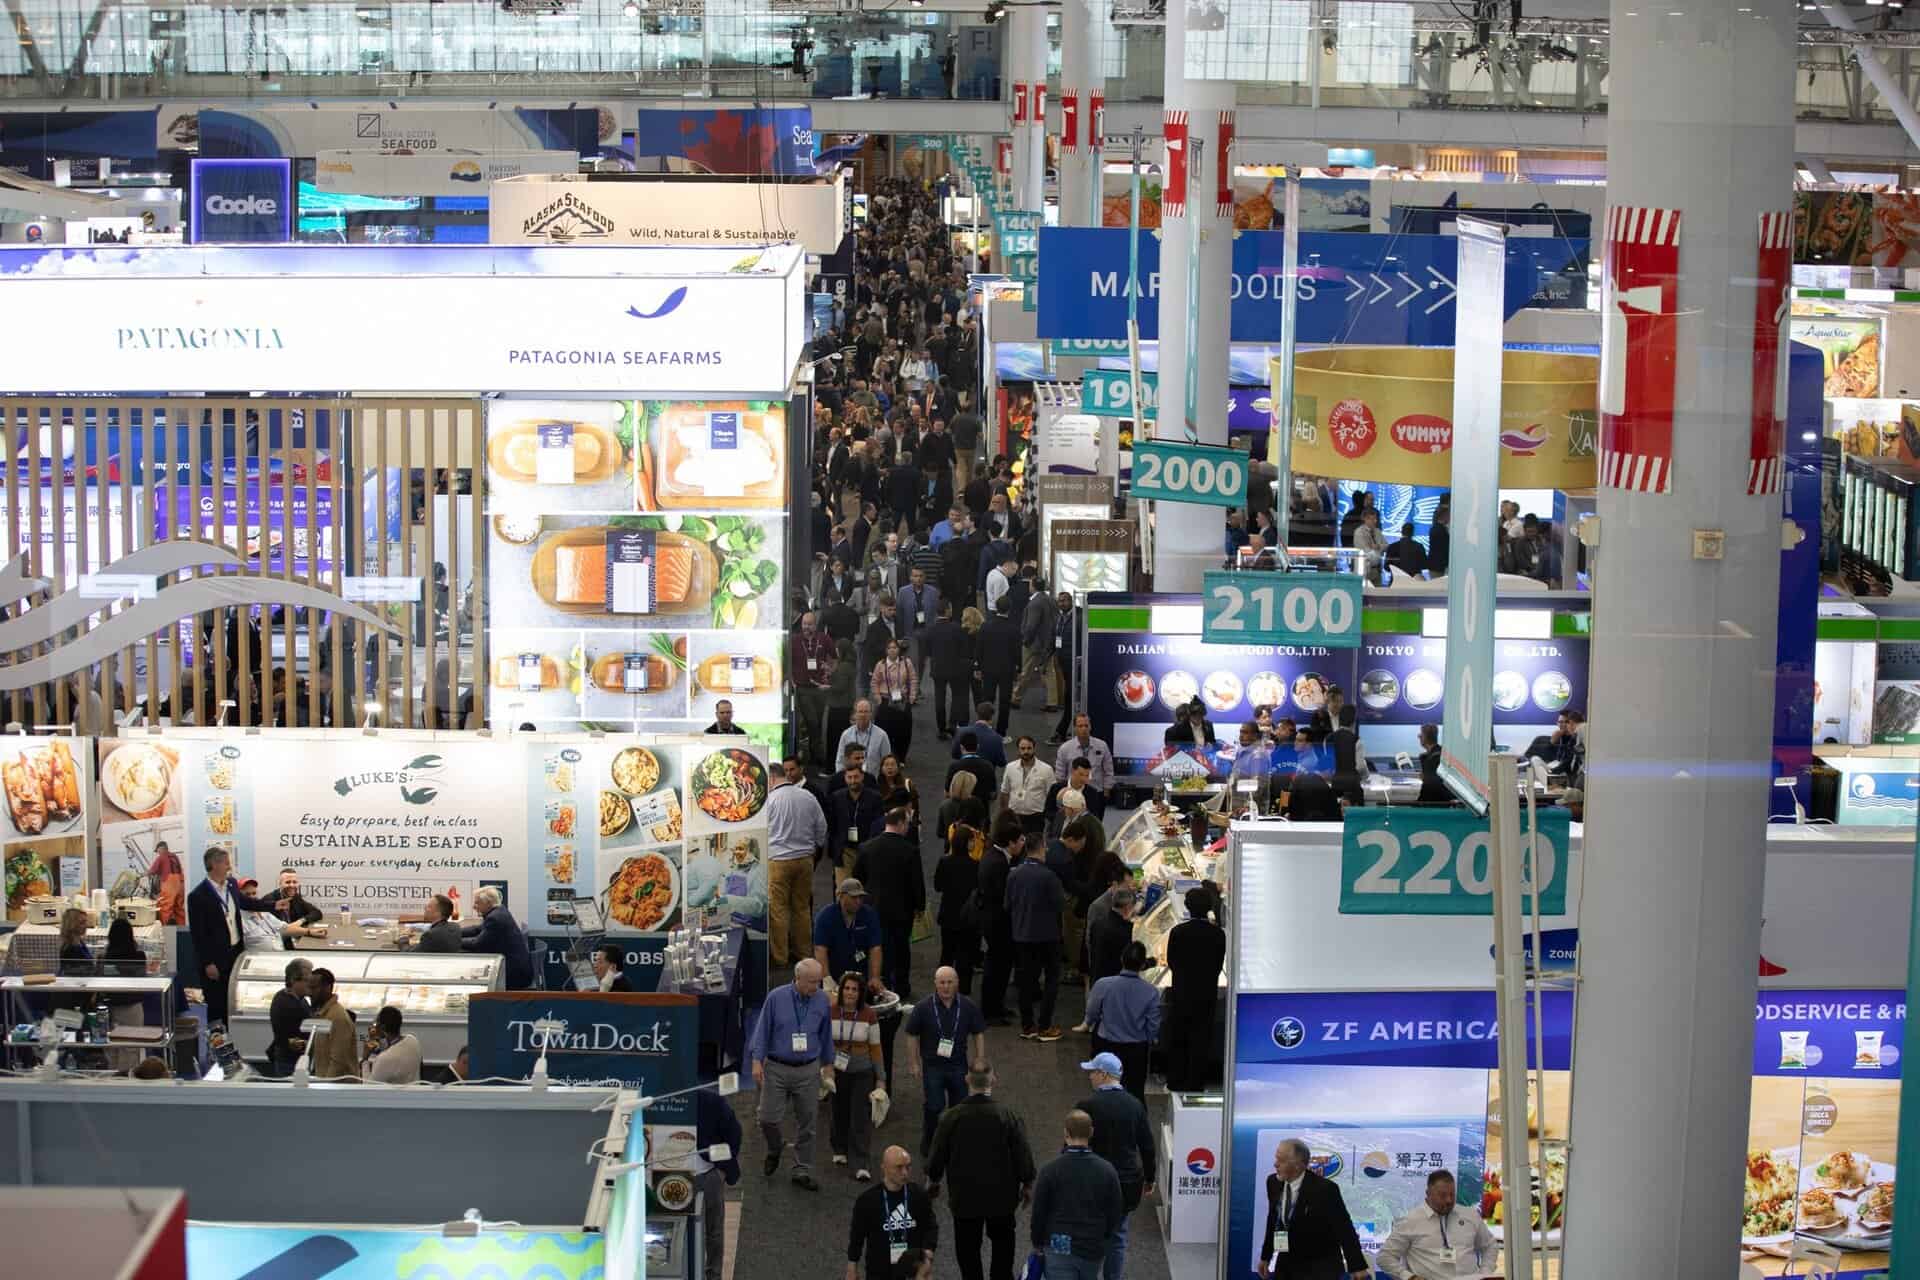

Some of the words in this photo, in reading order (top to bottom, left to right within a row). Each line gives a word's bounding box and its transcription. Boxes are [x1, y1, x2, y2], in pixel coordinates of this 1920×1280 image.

[381, 138, 438, 150] SEAFOOD
[923, 136, 942, 147] 500
[205, 193, 278, 216] Cooke
[523, 195, 566, 234] ALASKA
[564, 191, 616, 233] SEAFOOD
[630, 227, 662, 241] Wild,
[664, 228, 710, 241] Natural
[713, 228, 723, 240] &
[725, 228, 798, 241] Sustainable
[1005, 236, 1037, 252] 150
[116, 326, 284, 350] PATAGONIA
[509, 350, 616, 365] PATAGONIA
[624, 351, 722, 365] SEAFARMS
[1090, 377, 1159, 409] 190
[1396, 425, 1452, 444] YUMMY
[1136, 453, 1243, 497] 2000
[1210, 584, 1354, 633] 2100
[1117, 644, 1165, 655] DALIAN
[1366, 645, 1415, 657] TOKYO
[350, 772, 408, 787] LUKE'S
[300, 813, 331, 830] Easy
[333, 816, 345, 827] to
[403, 815, 429, 827] best
[432, 816, 446, 827] in
[447, 815, 478, 827] class
[279, 833, 411, 849] SUSTAINABLE
[416, 835, 503, 849] SEAFOOD
[281, 857, 316, 868] dishes
[319, 857, 338, 868] for
[340, 859, 366, 870] your
[370, 857, 422, 872] everyday
[1353, 830, 1556, 896] 2200
[298, 885, 348, 899] UKE'S
[353, 885, 433, 899] LOBSTER
[1876, 1003, 1891, 1020] &
[1321, 1022, 1360, 1042] ZF
[882, 1219, 917, 1231] adidas
